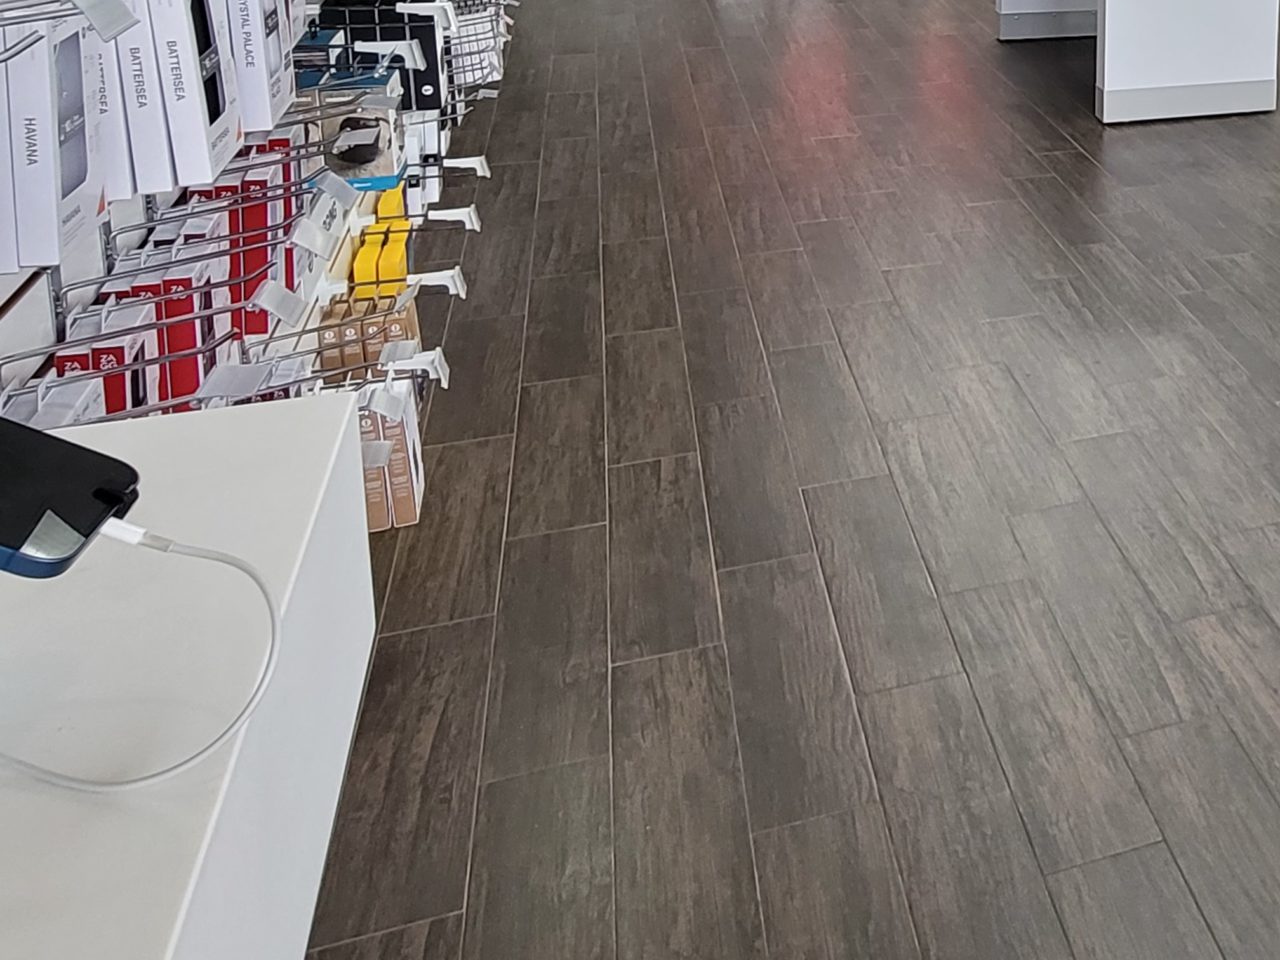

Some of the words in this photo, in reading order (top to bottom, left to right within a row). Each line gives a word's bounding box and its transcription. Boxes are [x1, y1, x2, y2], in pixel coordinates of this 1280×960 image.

[166, 40, 187, 102] BATTERSEA
[243, 31, 256, 68] PALACE
[129, 47, 148, 108] BATTERSEA
[24, 117, 39, 166] HAVANA
